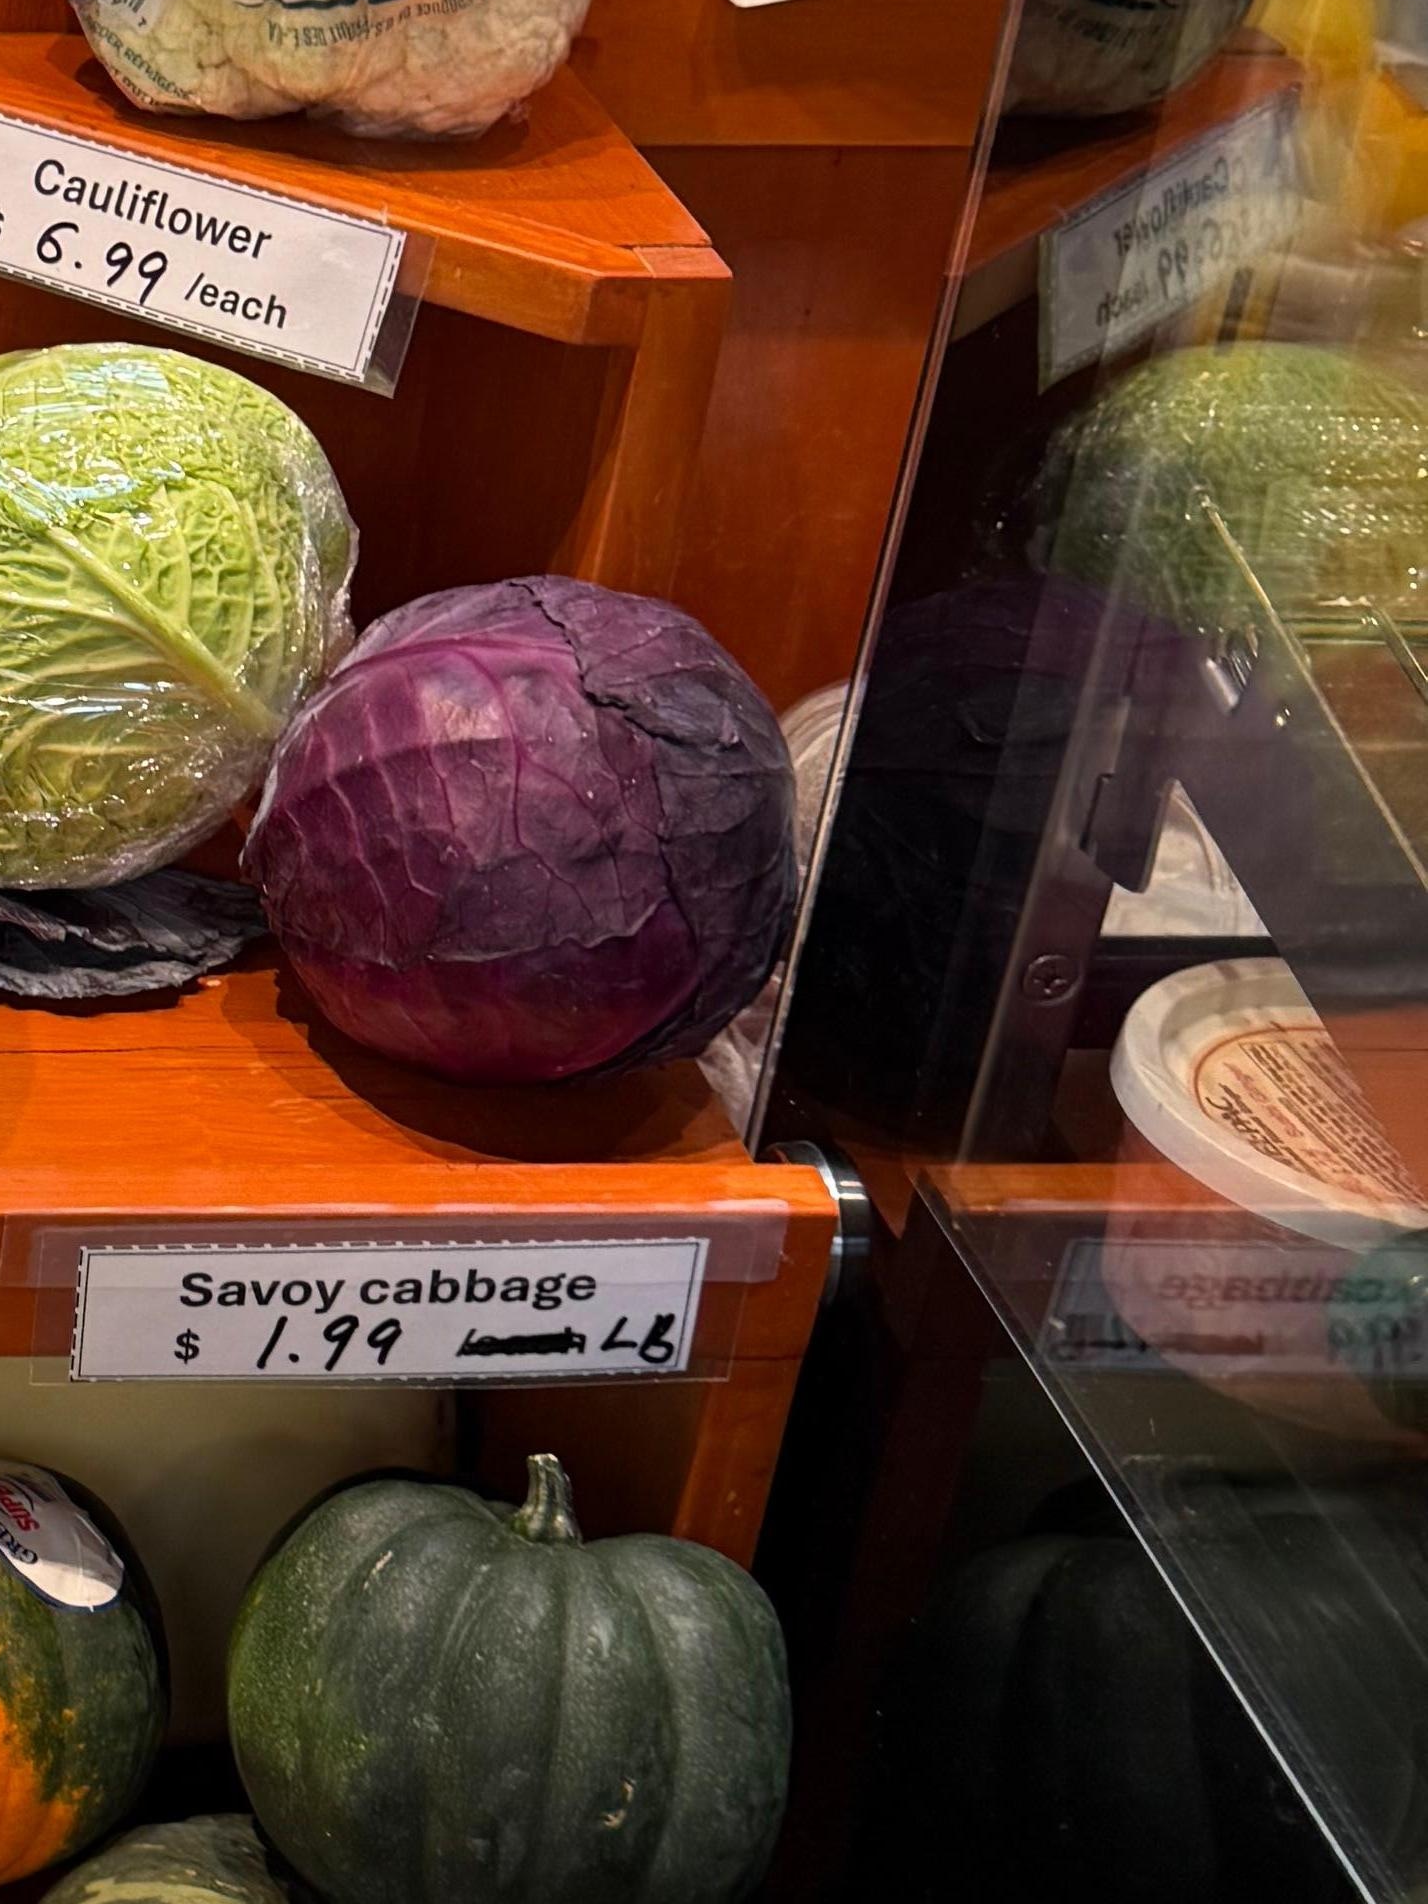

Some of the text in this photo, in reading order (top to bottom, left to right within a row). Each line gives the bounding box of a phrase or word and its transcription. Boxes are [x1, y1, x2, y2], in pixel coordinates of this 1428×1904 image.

[33, 157, 272, 260] Cauliflower
[35, 221, 168, 305] 6.99
[184, 271, 288, 329] /each
[178, 1268, 597, 1314] Savoy cabbage
[173, 1329, 201, 1363] $
[255, 1314, 403, 1371] 1.99
[601, 1314, 677, 1365] LB
